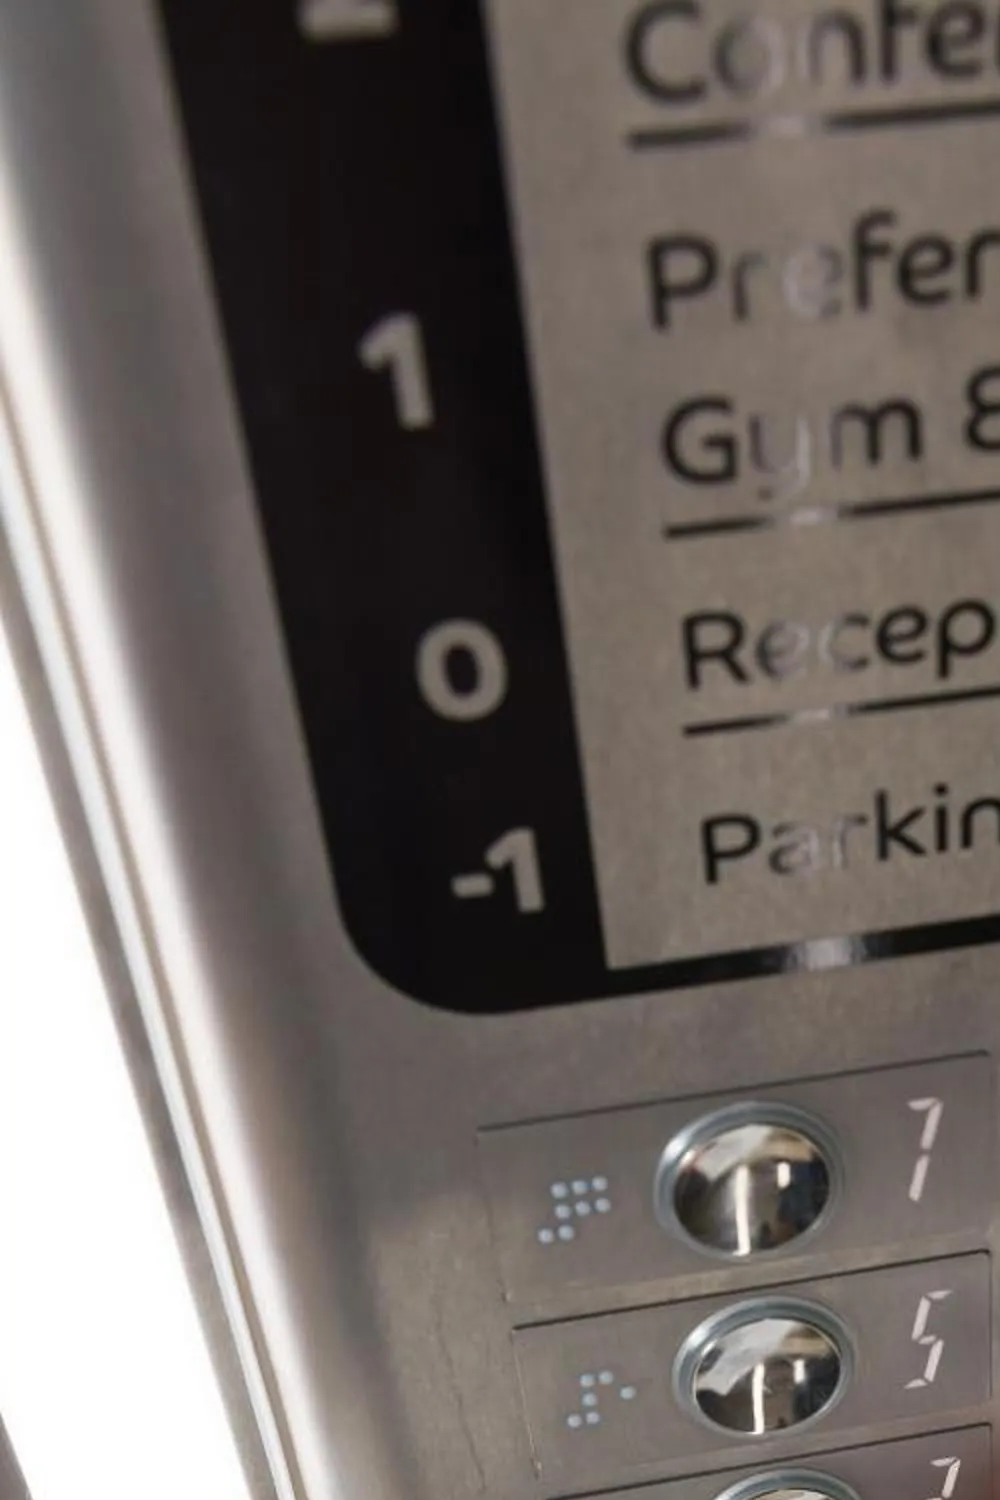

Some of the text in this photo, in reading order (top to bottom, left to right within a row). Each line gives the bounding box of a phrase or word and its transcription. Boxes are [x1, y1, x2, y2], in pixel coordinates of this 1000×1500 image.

[357, 312, 434, 430] 1
[662, 397, 923, 500] Gym
[416, 618, 508, 722] 0
[451, 828, 546, 914] -1
[908, 1097, 944, 1201] 7
[905, 1289, 953, 1390] 5
